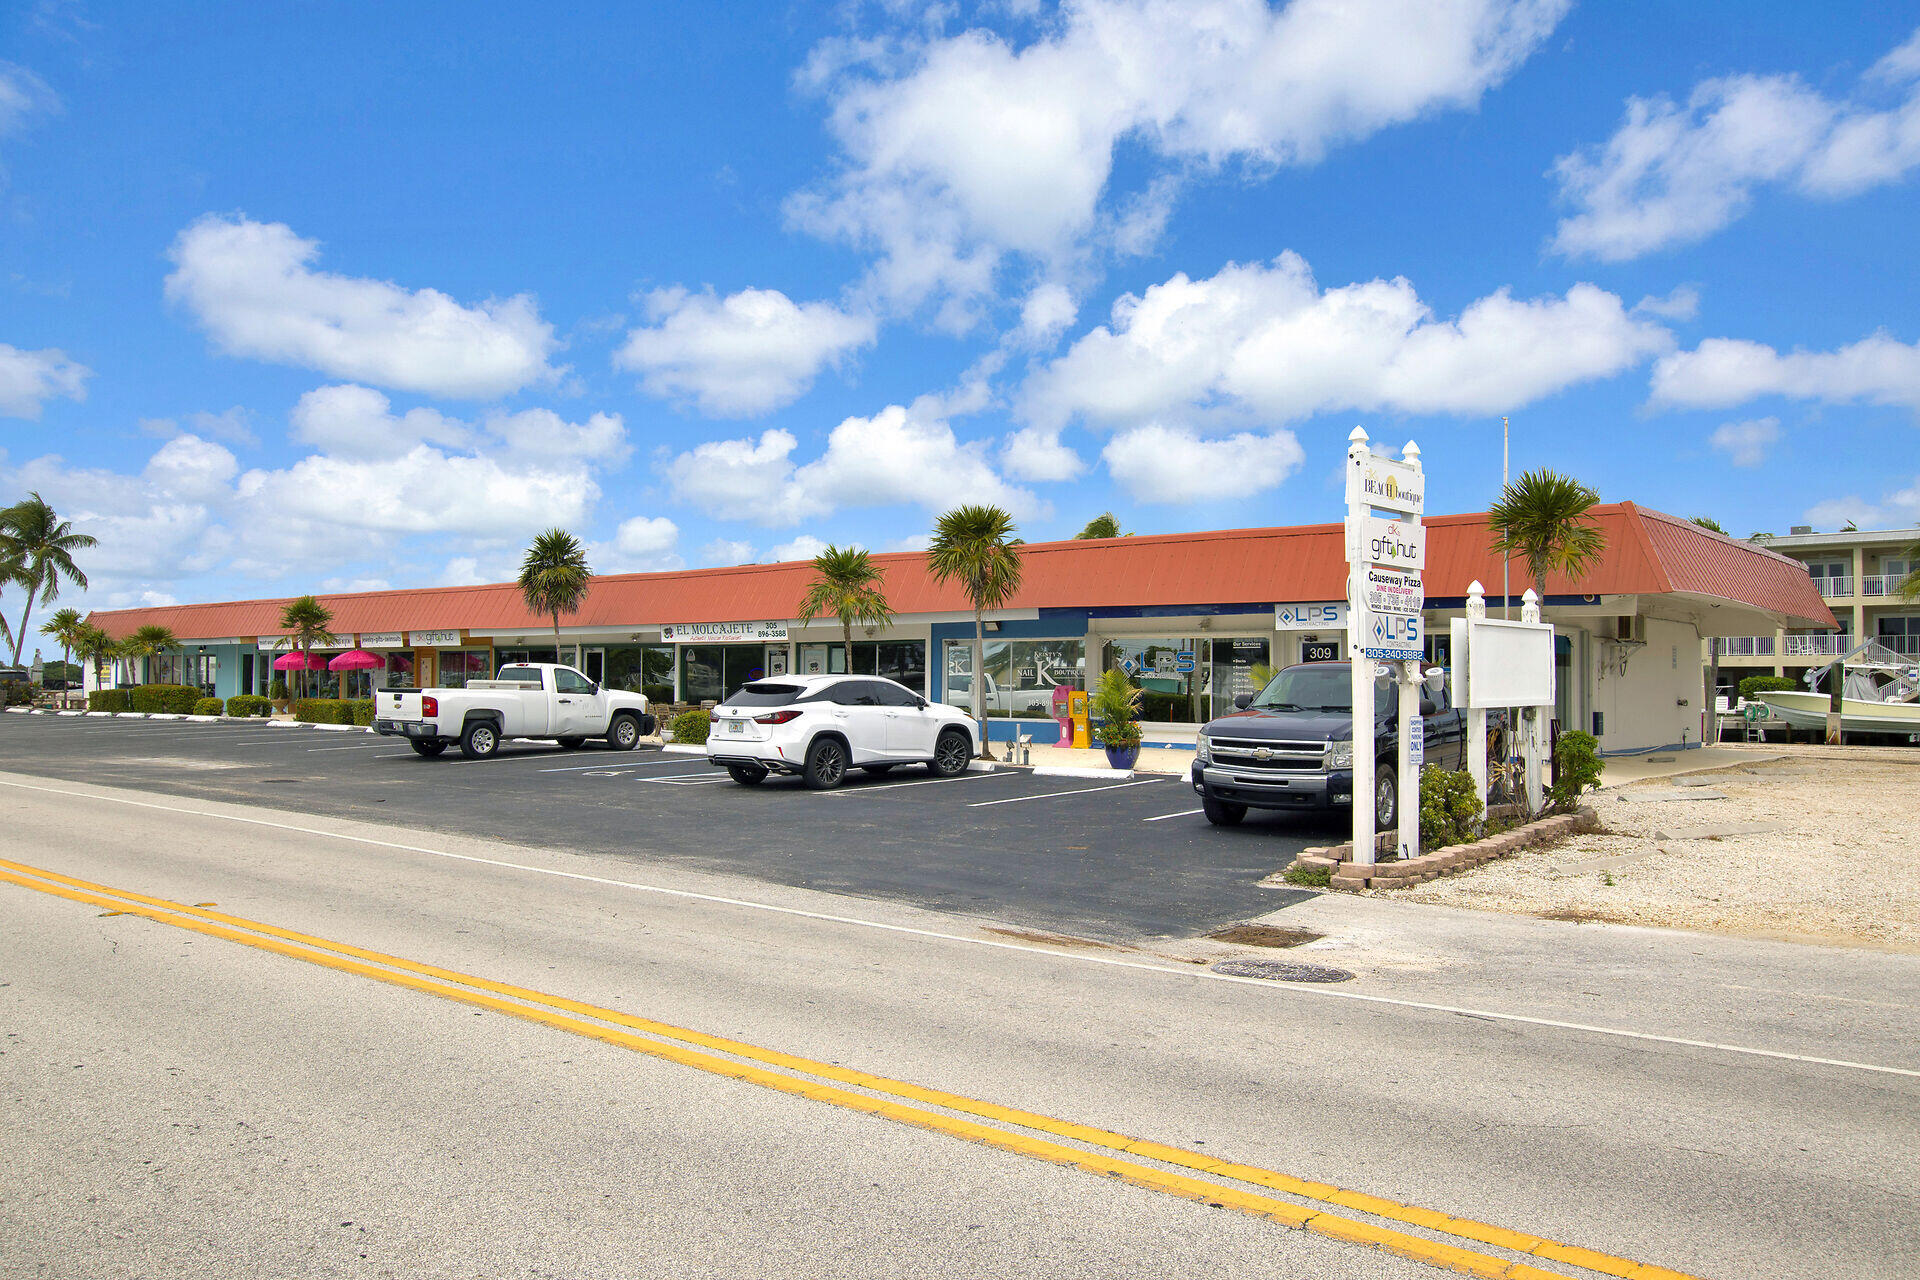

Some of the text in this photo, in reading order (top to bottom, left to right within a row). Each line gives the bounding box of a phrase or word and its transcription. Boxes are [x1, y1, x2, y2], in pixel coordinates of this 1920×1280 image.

[1364, 479, 1423, 506] BEACH boutique
[1371, 536, 1417, 560] gift hut
[1368, 571, 1421, 588] Causeway Pizza
[1376, 584, 1386, 593] DINE
[1296, 606, 1338, 622] LPS
[676, 623, 753, 635] EL MOLCAJETE
[757, 630, 787, 638] 896-3588
[1386, 615, 1418, 641] LPS
[441, 631, 453, 641] hut
[1310, 647, 1331, 658] 309
[1366, 648, 1423, 660] 305-240-9882
[1140, 651, 1195, 672] LPS
[1018, 669, 1034, 677] NAIL
[1034, 660, 1061, 686] K
[1411, 741, 1422, 751] ONLY
